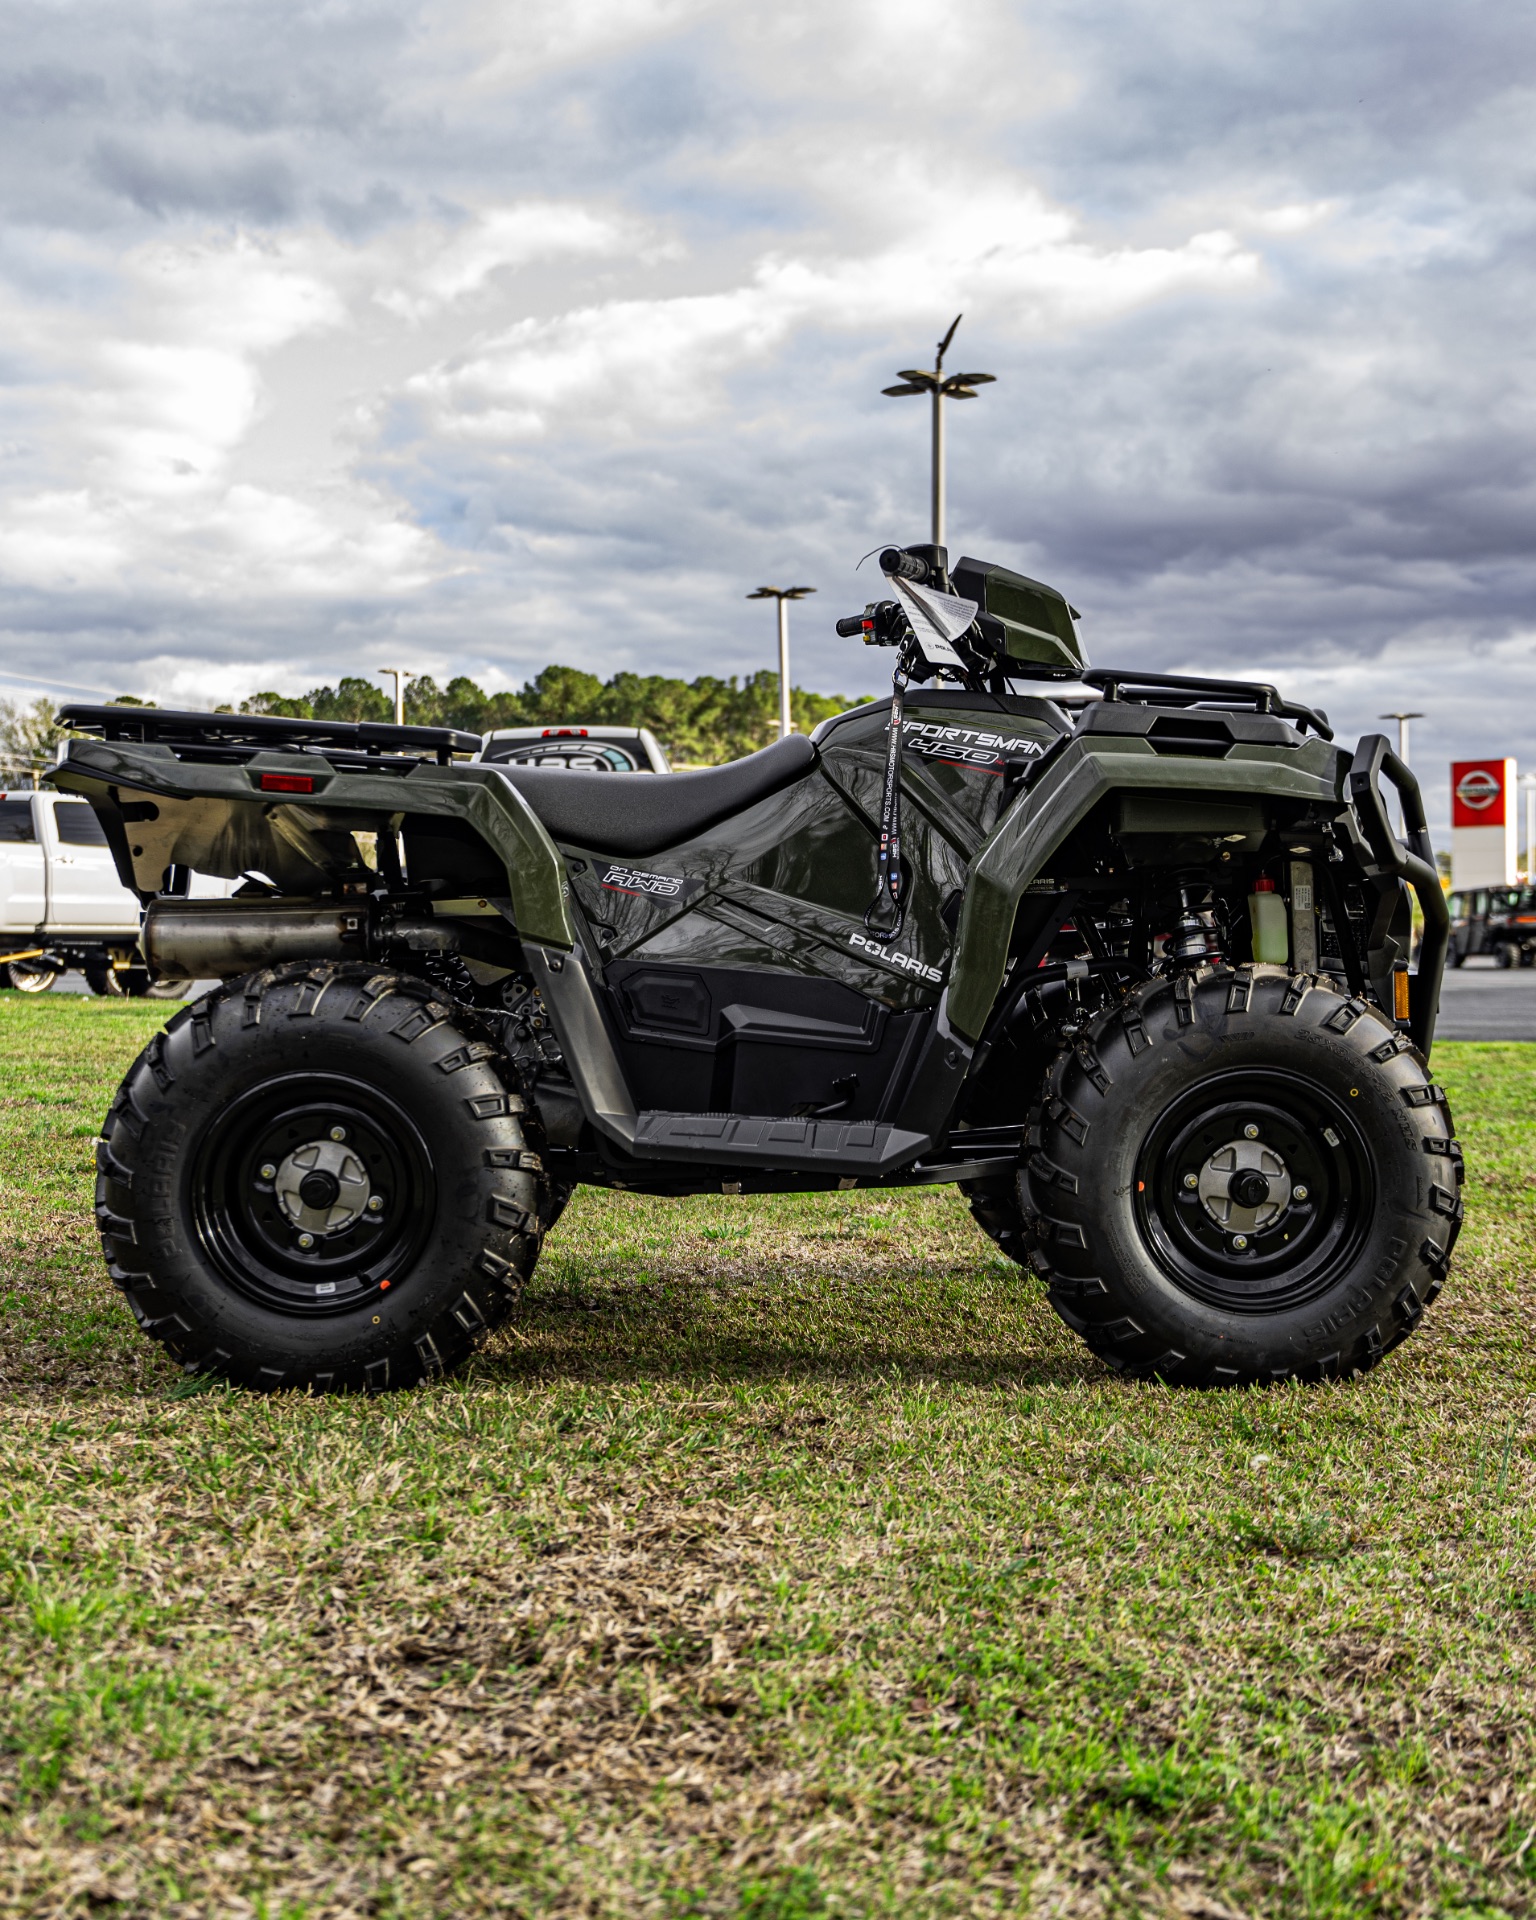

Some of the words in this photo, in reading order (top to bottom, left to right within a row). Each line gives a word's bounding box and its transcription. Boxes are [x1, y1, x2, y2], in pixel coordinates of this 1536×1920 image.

[908, 738, 1000, 765] 450
[602, 870, 680, 896] AWD
[609, 865, 628, 873] ON
[632, 870, 684, 885] DEMAND
[848, 933, 943, 983] POLARIS
[1303, 1235, 1408, 1343] POLARIS
